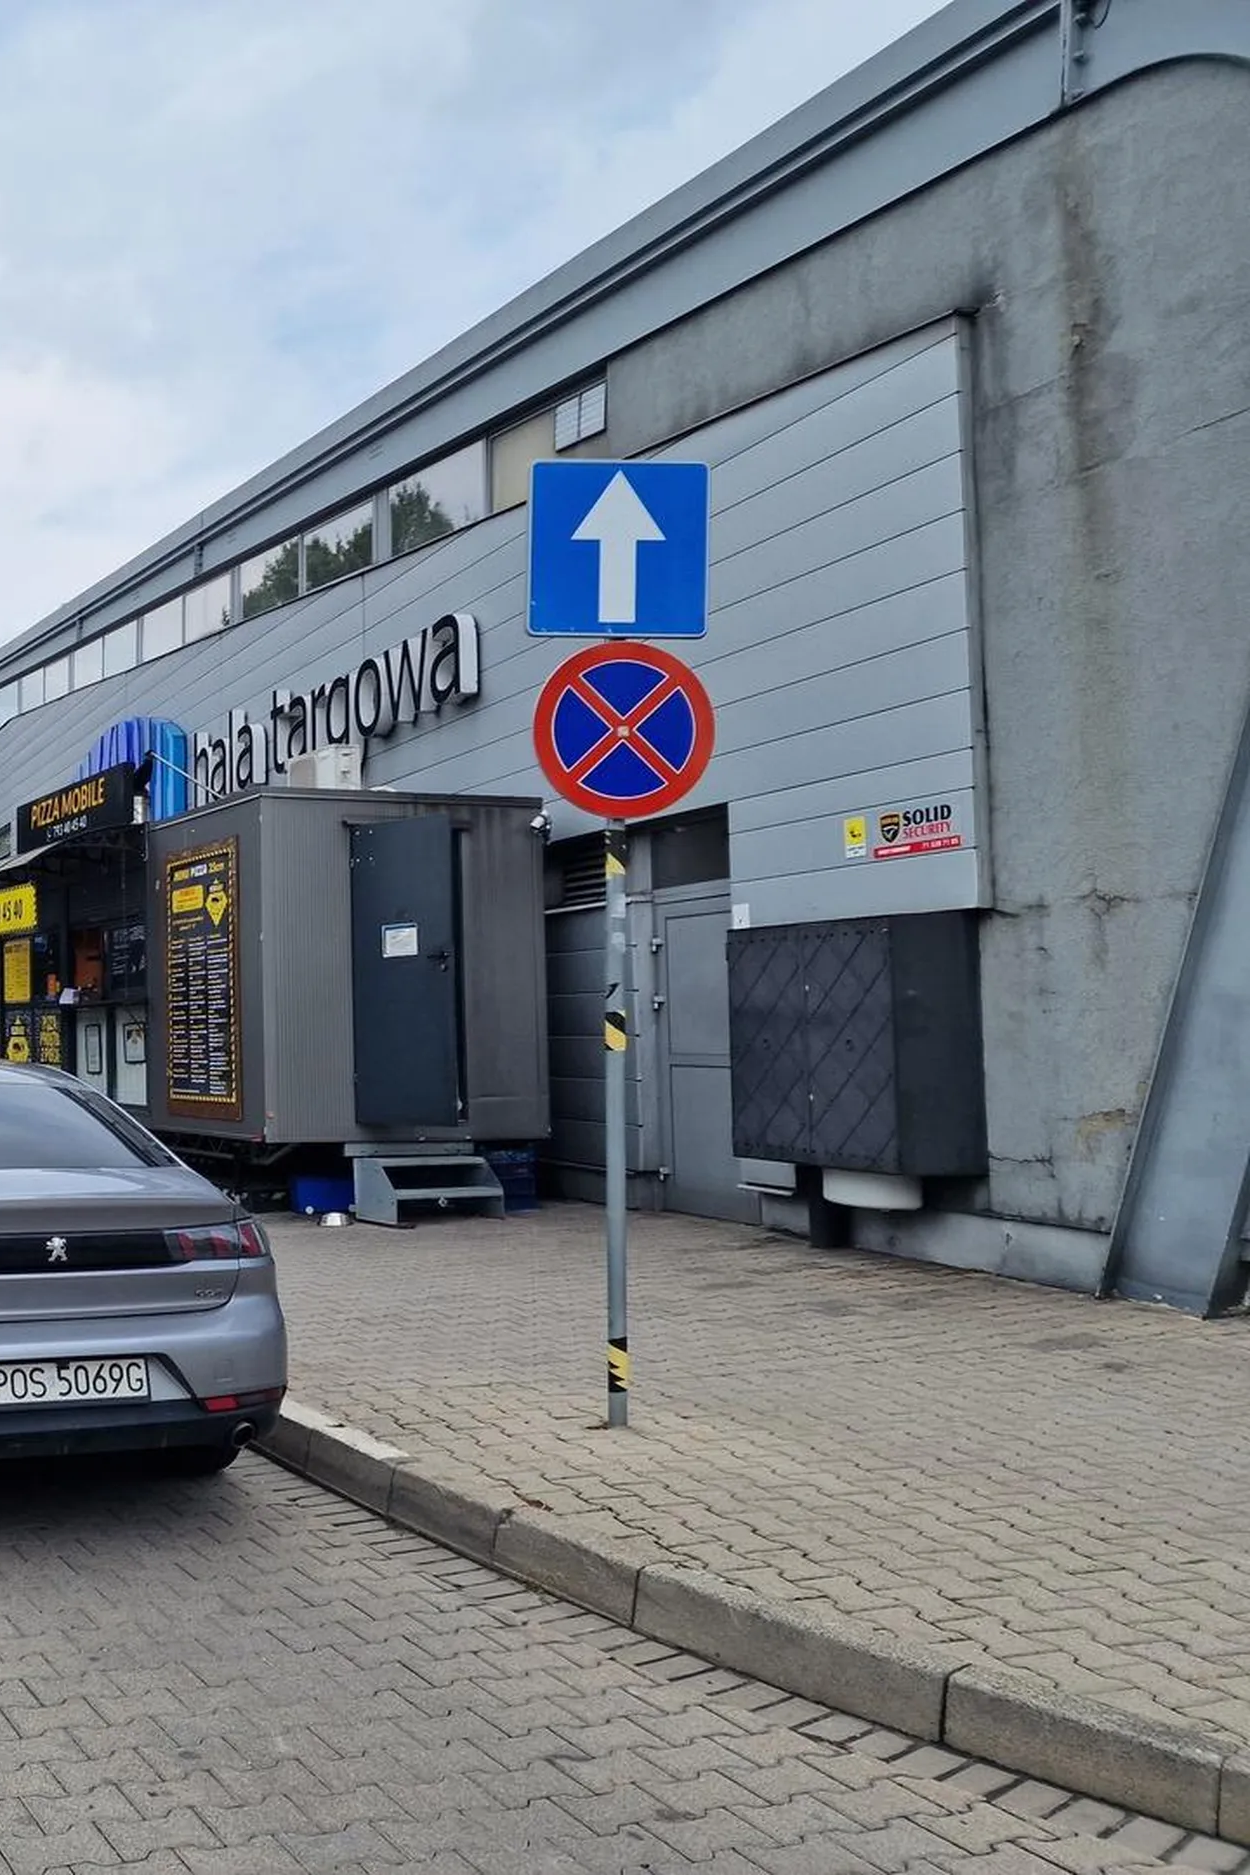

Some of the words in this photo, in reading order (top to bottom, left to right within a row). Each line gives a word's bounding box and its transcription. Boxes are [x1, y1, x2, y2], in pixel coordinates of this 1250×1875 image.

[193, 708, 269, 800] hala
[270, 613, 481, 774] targowa
[31, 796, 60, 830] PIZZA
[61, 776, 106, 819] MOBILE
[901, 804, 953, 828] SOLID
[902, 820, 952, 839] SECURITY
[57, 1361, 144, 1397] 5069G
